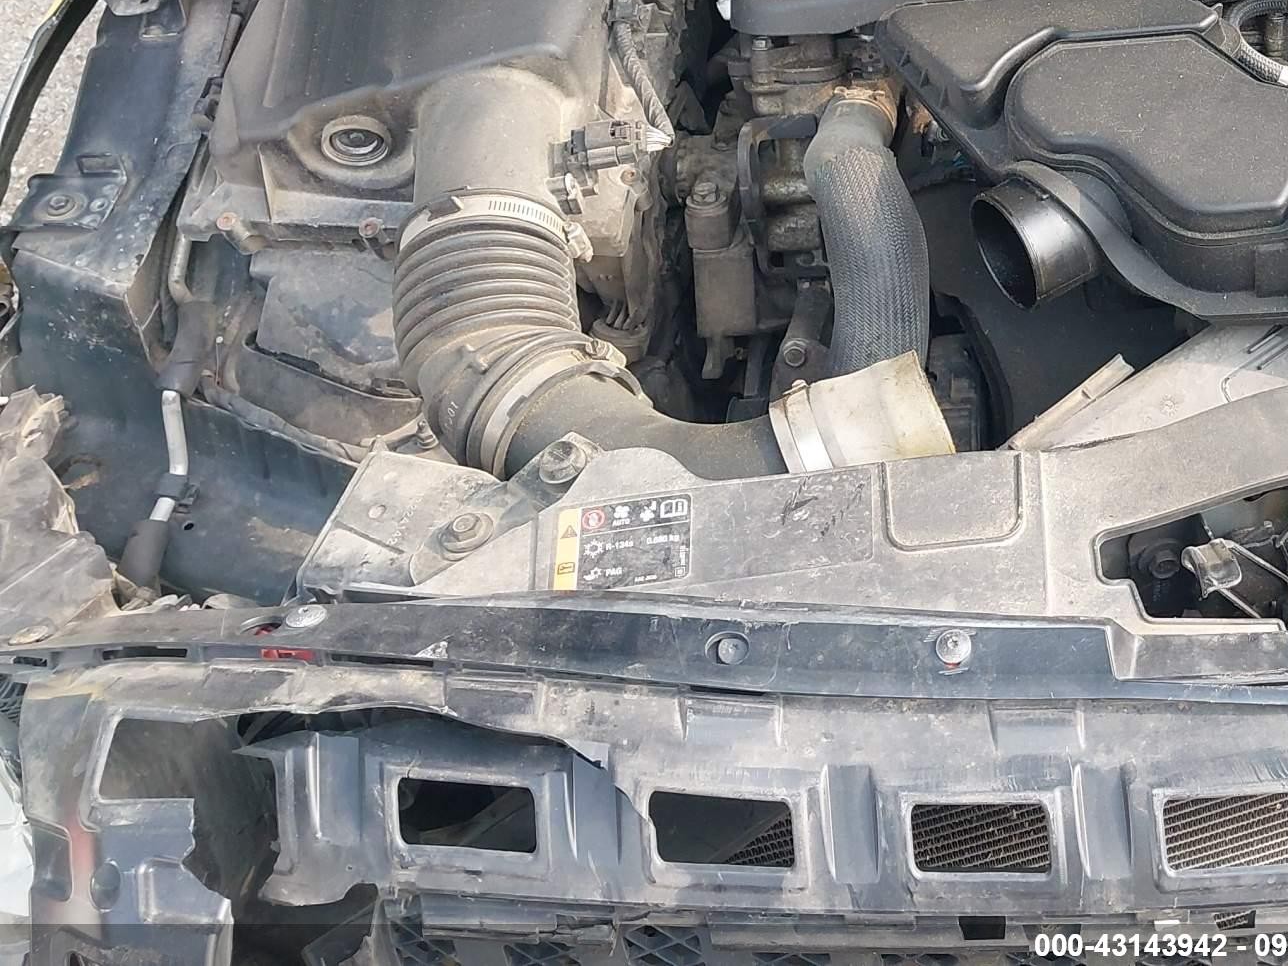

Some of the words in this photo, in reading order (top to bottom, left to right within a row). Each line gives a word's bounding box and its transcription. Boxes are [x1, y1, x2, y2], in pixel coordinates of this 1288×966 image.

[612, 518, 630, 527] AUTO
[606, 540, 634, 550] R-134a
[606, 567, 622, 576] PAG
